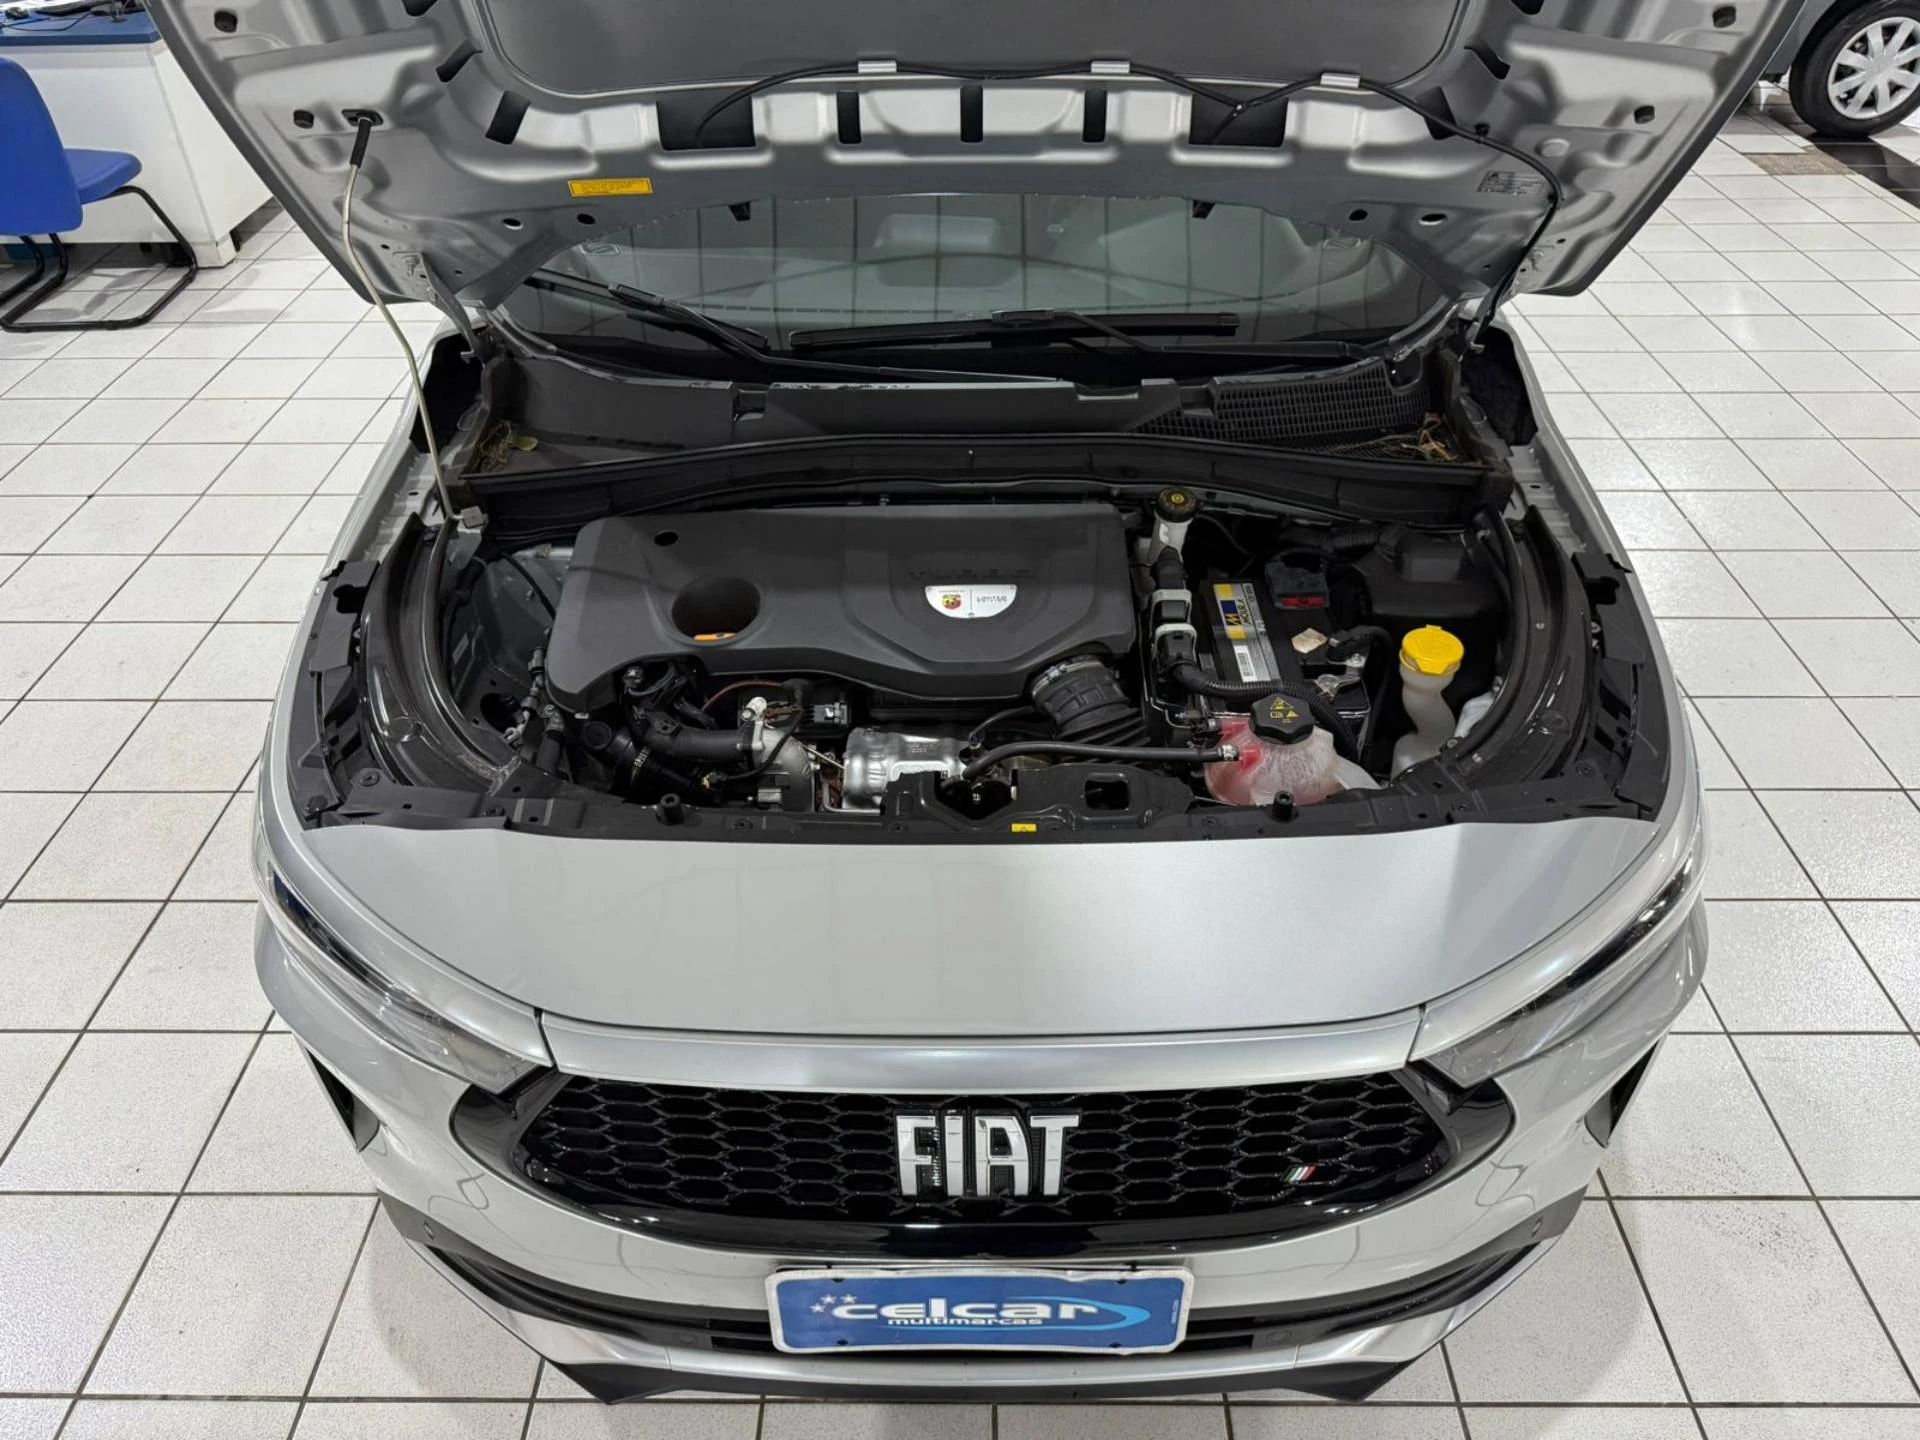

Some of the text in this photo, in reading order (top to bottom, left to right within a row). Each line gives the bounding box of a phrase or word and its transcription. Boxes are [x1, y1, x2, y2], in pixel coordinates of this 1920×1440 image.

[1237, 600, 1252, 625] MOURA
[895, 1114, 1080, 1196] FIAT
[832, 1297, 1099, 1321] celcar
[887, 1317, 1043, 1326] multimarcas
